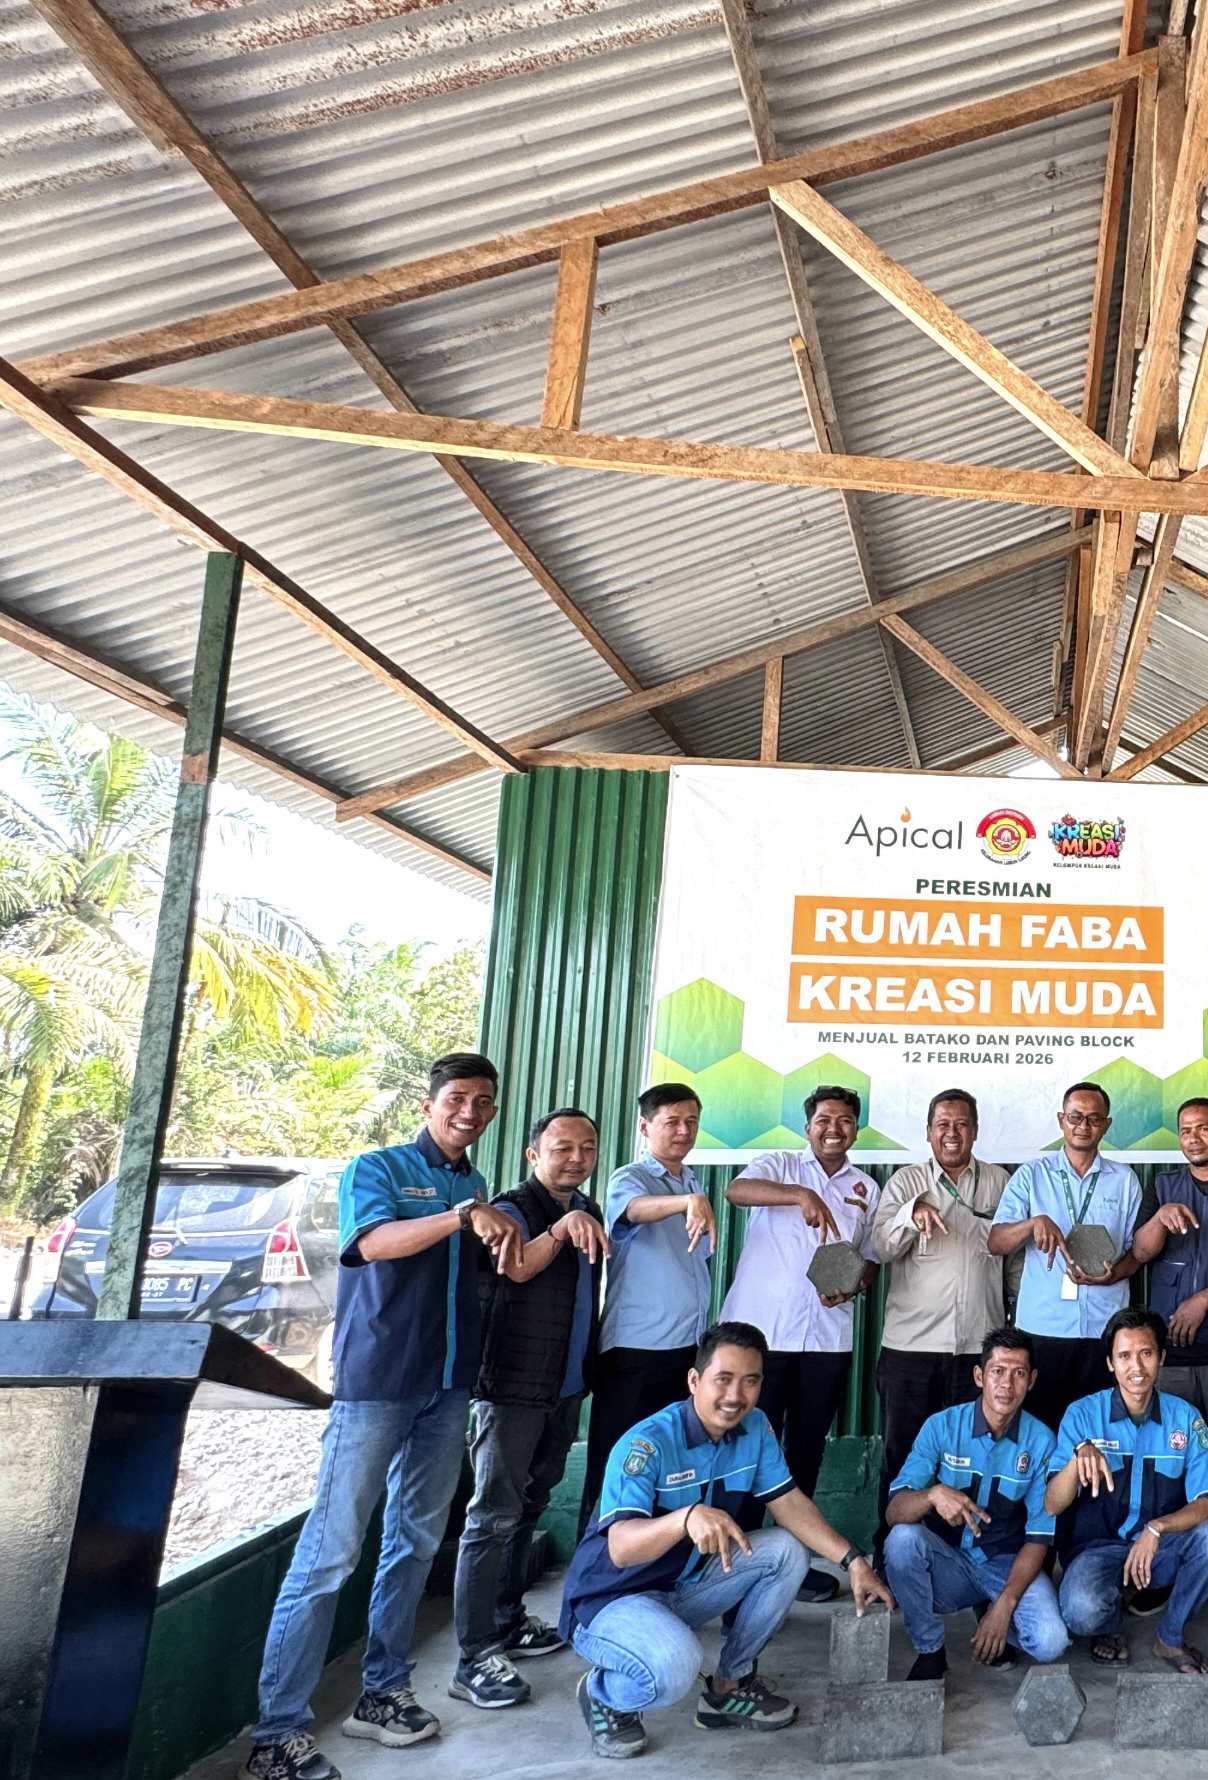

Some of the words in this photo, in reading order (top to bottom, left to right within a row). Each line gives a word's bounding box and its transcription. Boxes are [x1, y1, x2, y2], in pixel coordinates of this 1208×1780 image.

[845, 806, 963, 857] Apical
[1052, 822, 1122, 842] KREASI
[1060, 838, 1119, 857] MUDA
[916, 879, 1052, 898] PERESMIAN
[814, 907, 1001, 948] RUMAH
[1020, 914, 1148, 951] FABA
[798, 974, 992, 1015] KREASI
[1011, 979, 1158, 1017] MUDA
[817, 1031, 899, 1045] MENJUAL
[904, 1032, 971, 1046] BATAKO
[976, 1034, 1010, 1047] DAN
[1014, 1034, 1075, 1048] PAVING
[1080, 1036, 1136, 1048] BLOCK
[902, 1051, 921, 1064] 12
[926, 1051, 1010, 1065] FEBRUARI
[1014, 1052, 1054, 1066] 2026
